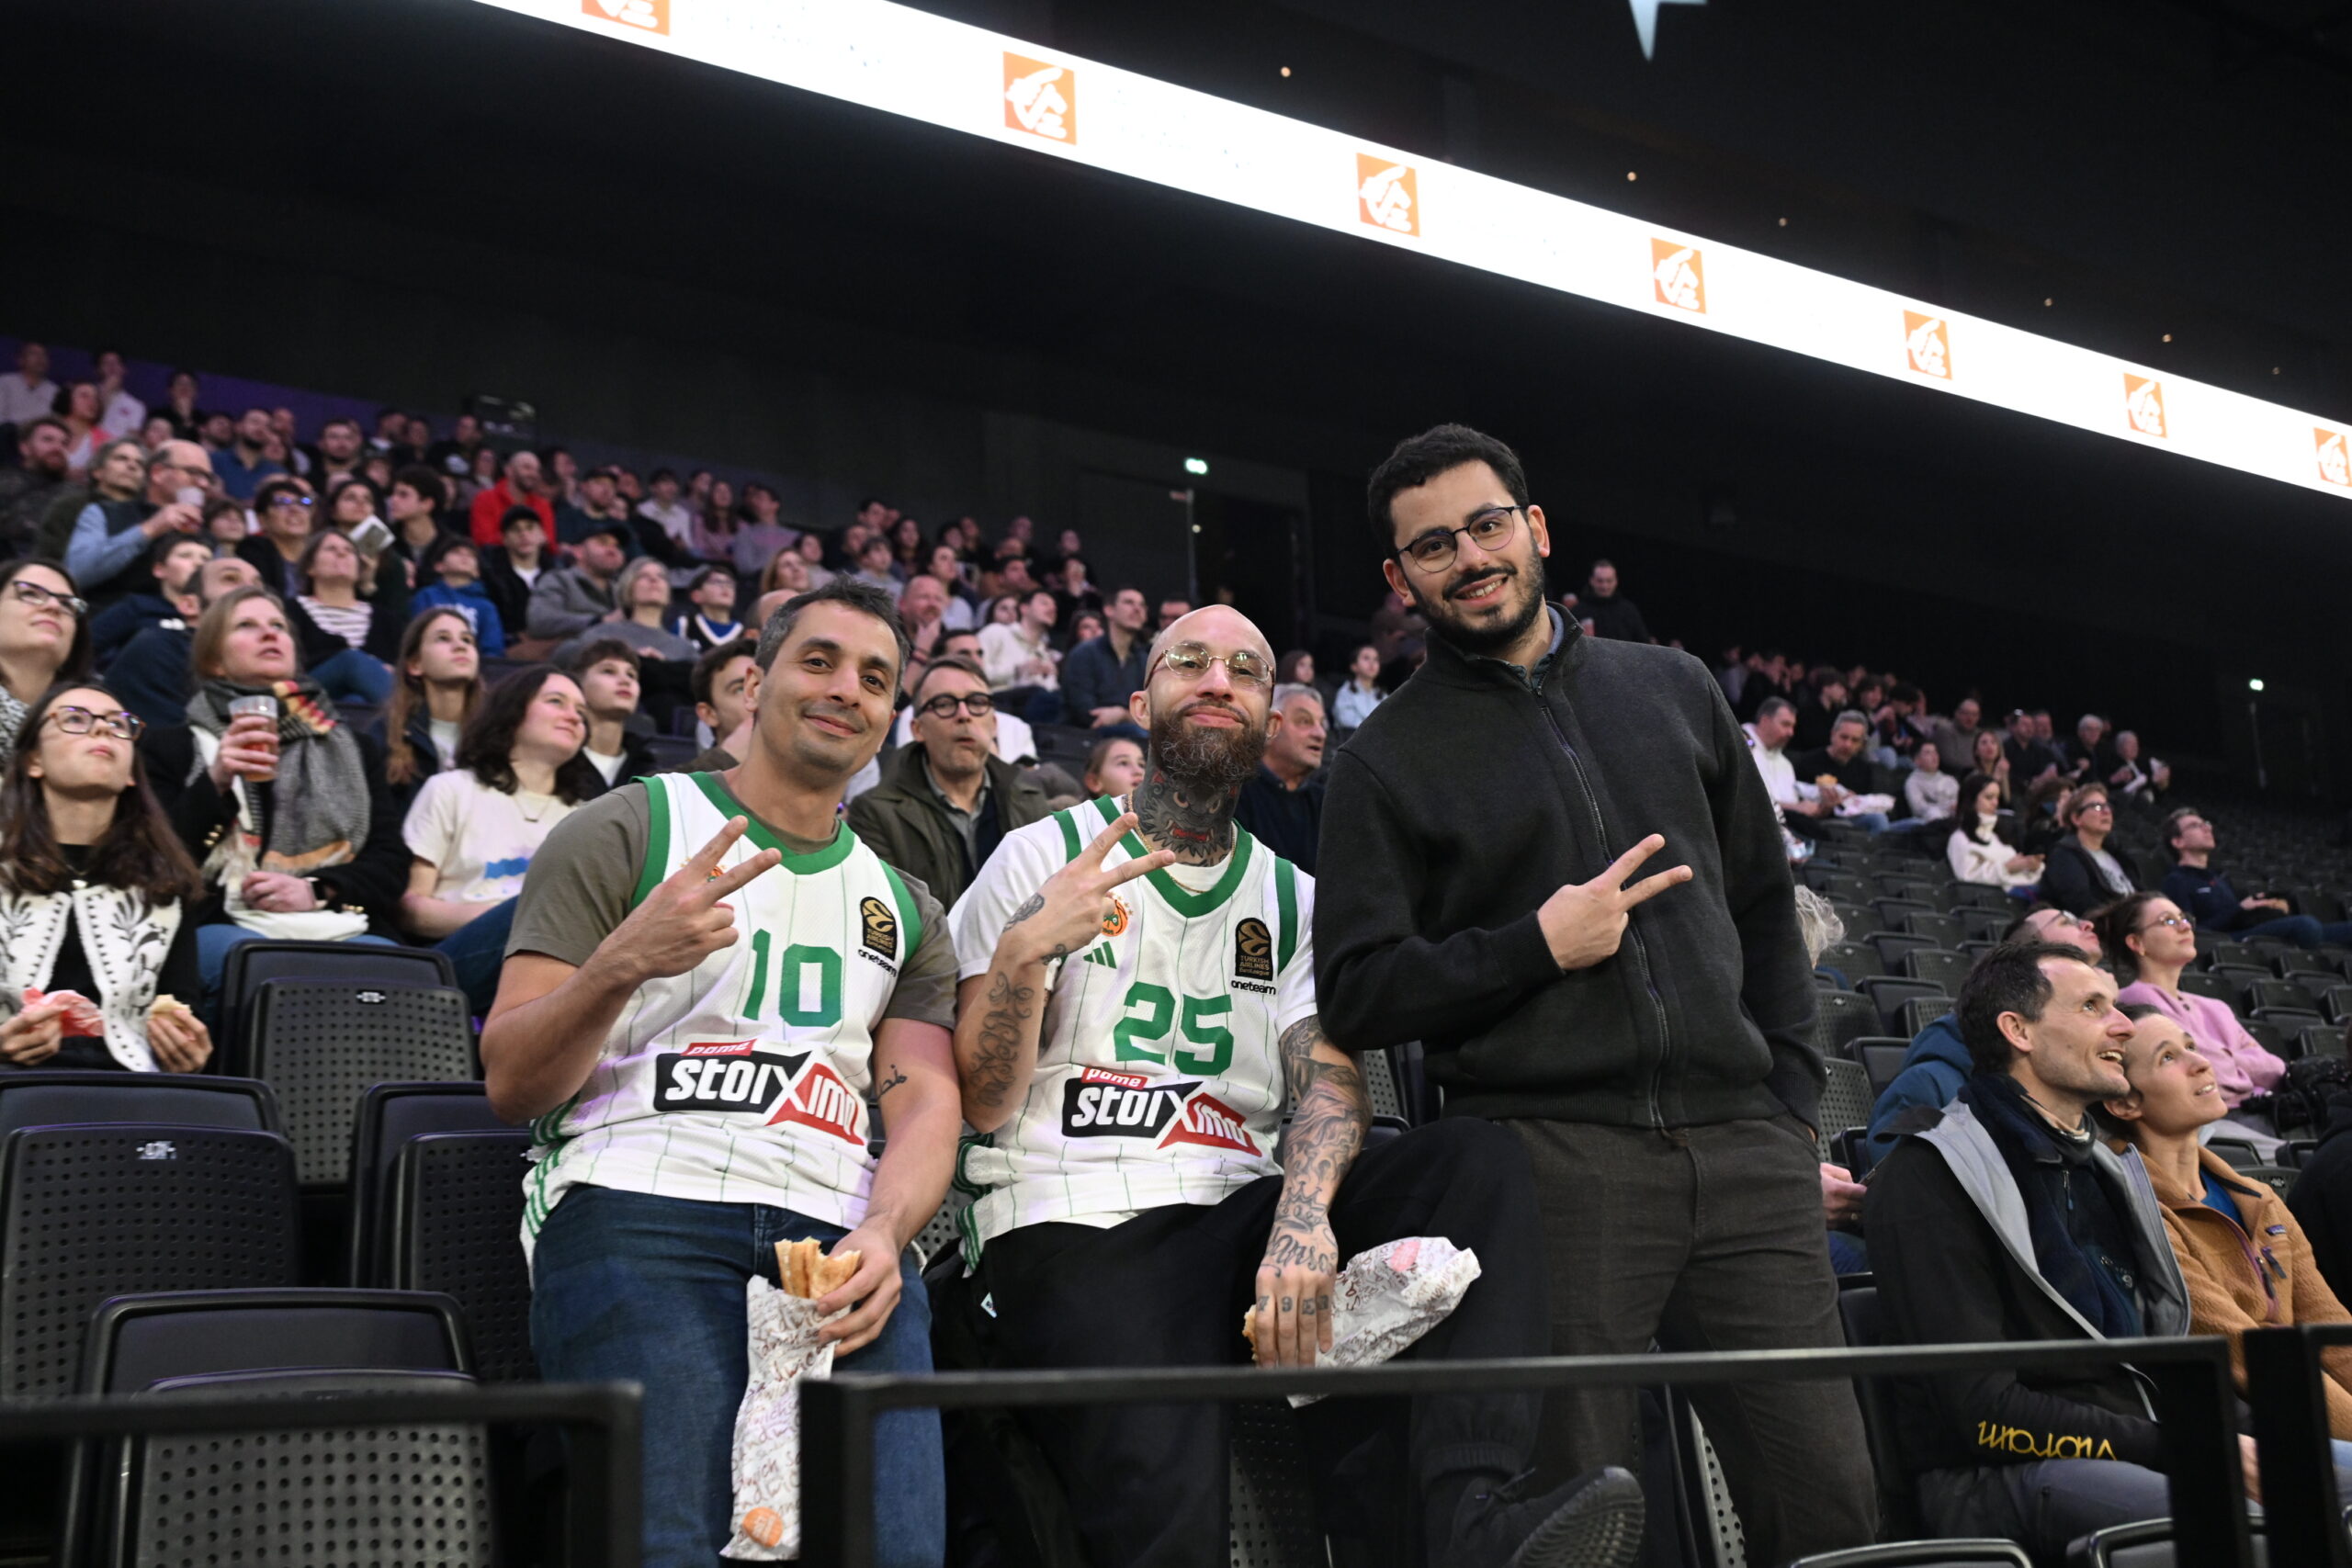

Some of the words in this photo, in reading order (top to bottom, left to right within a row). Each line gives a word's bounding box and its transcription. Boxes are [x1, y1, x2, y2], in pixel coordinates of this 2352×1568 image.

[1239, 962, 1270, 971] AIRLINES
[1240, 955, 1270, 964] TURKISH
[742, 928, 842, 1028] 10
[1231, 979, 1276, 995] oneteam
[1114, 981, 1234, 1076] 25
[1085, 1068, 1143, 1089] pame
